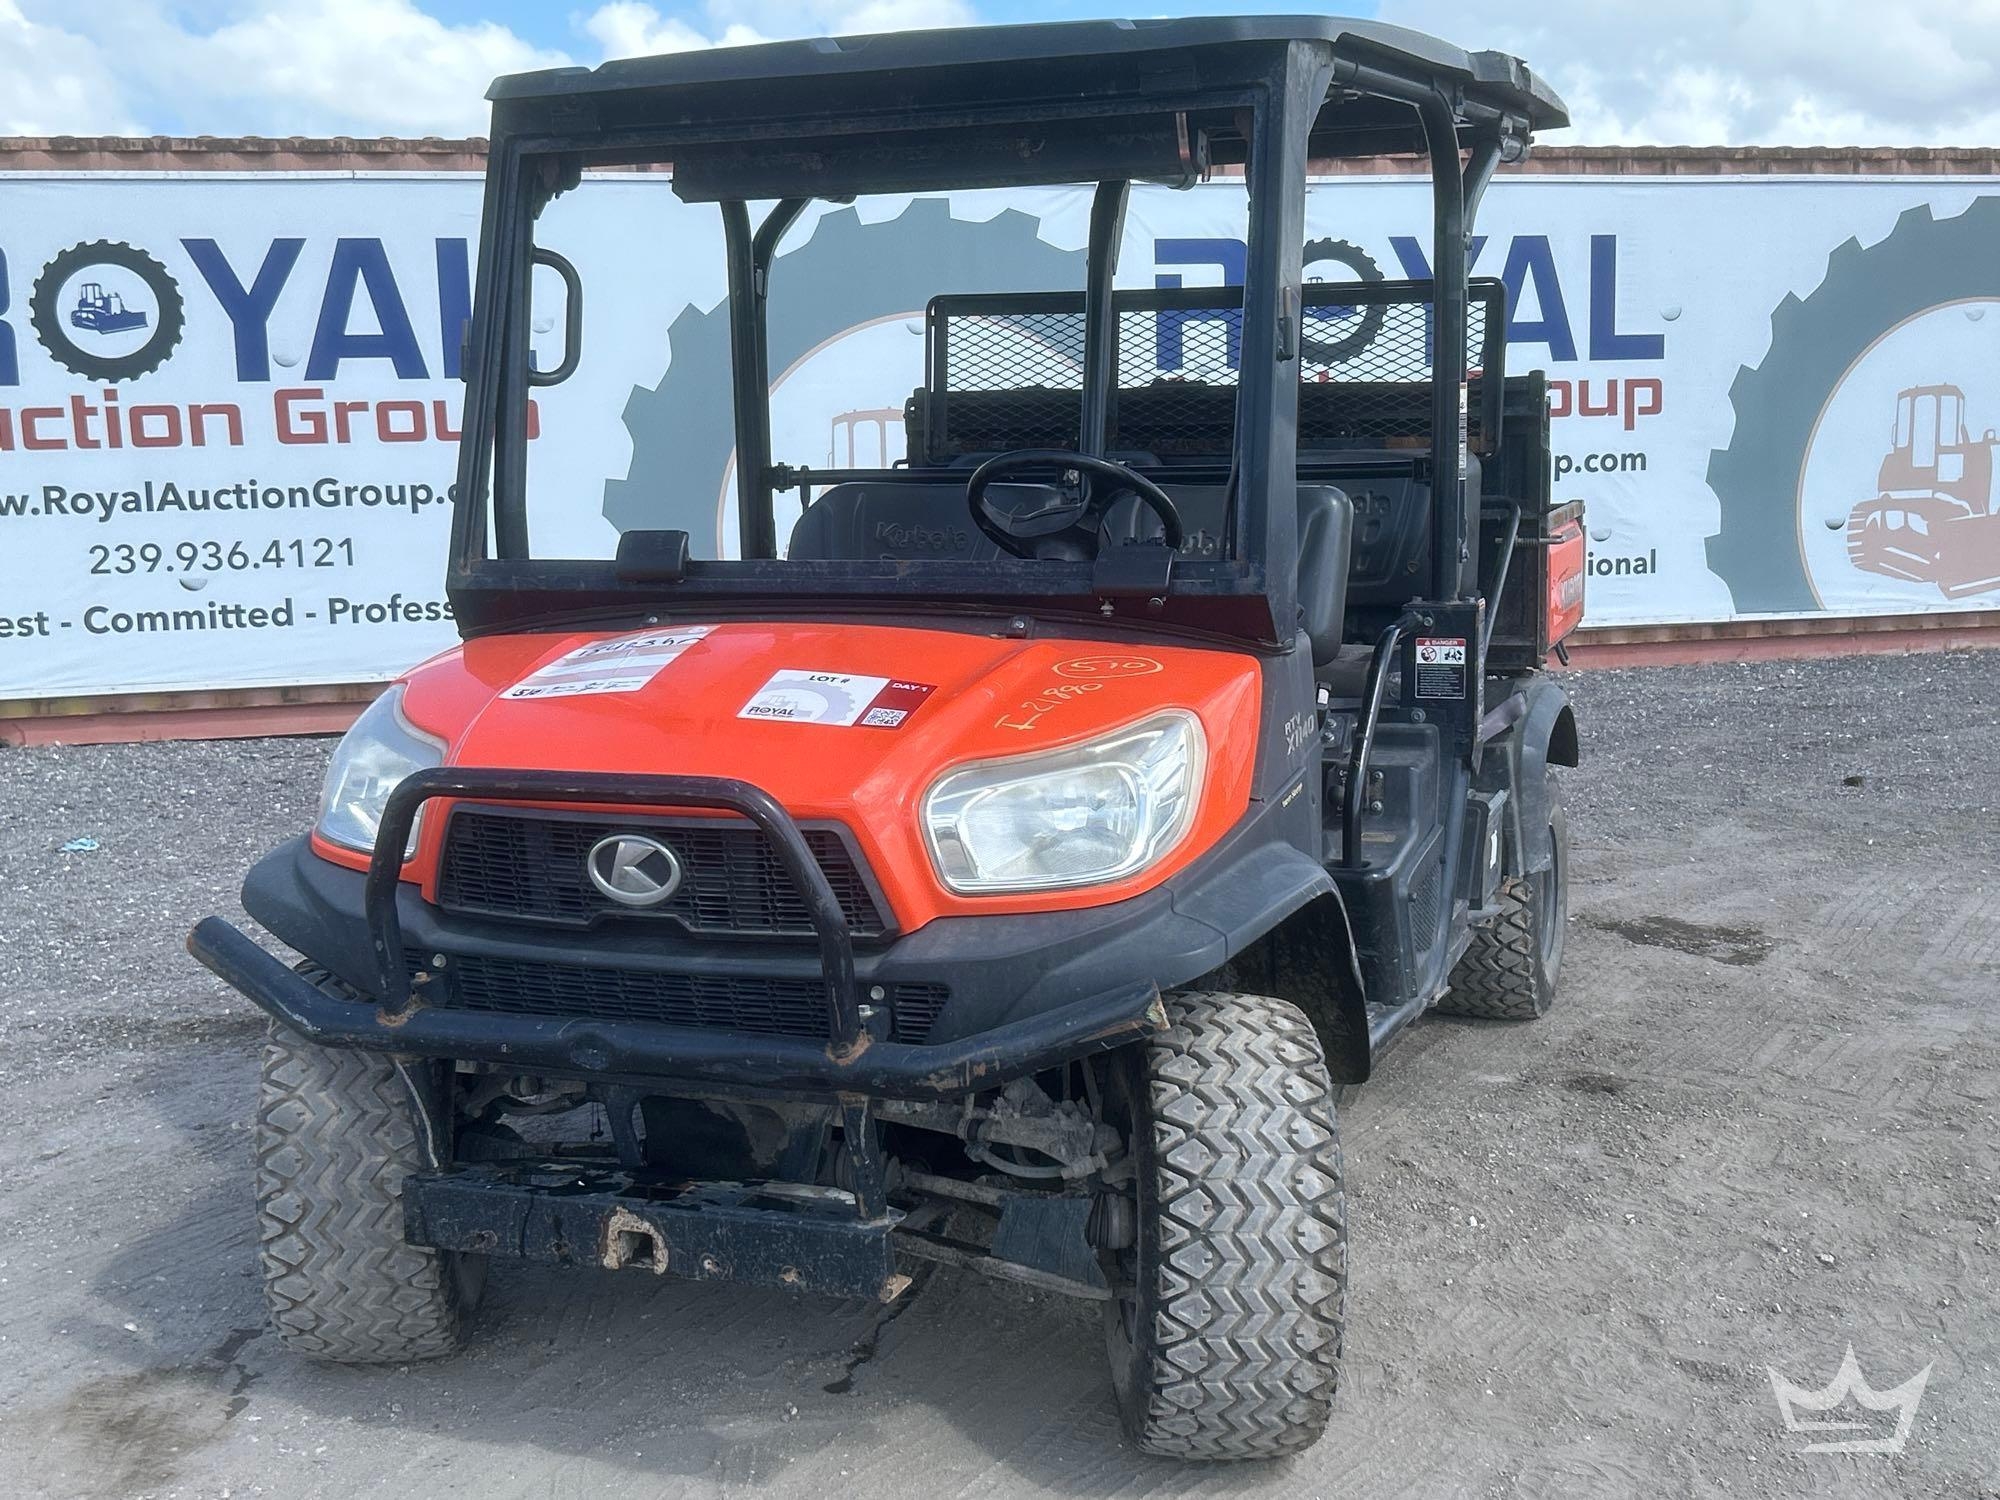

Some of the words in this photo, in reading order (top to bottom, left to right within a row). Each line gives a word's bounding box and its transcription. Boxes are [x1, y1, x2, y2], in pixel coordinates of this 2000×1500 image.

[0, 237, 537, 387] OYAL
[88, 537, 354, 575] 239.936.4121
[1587, 549, 1656, 576] ional
[83, 597, 294, 635] Committed
[809, 674, 836, 684] LOT
[892, 682, 920, 690] DAY
[748, 705, 796, 716] ROYAL
